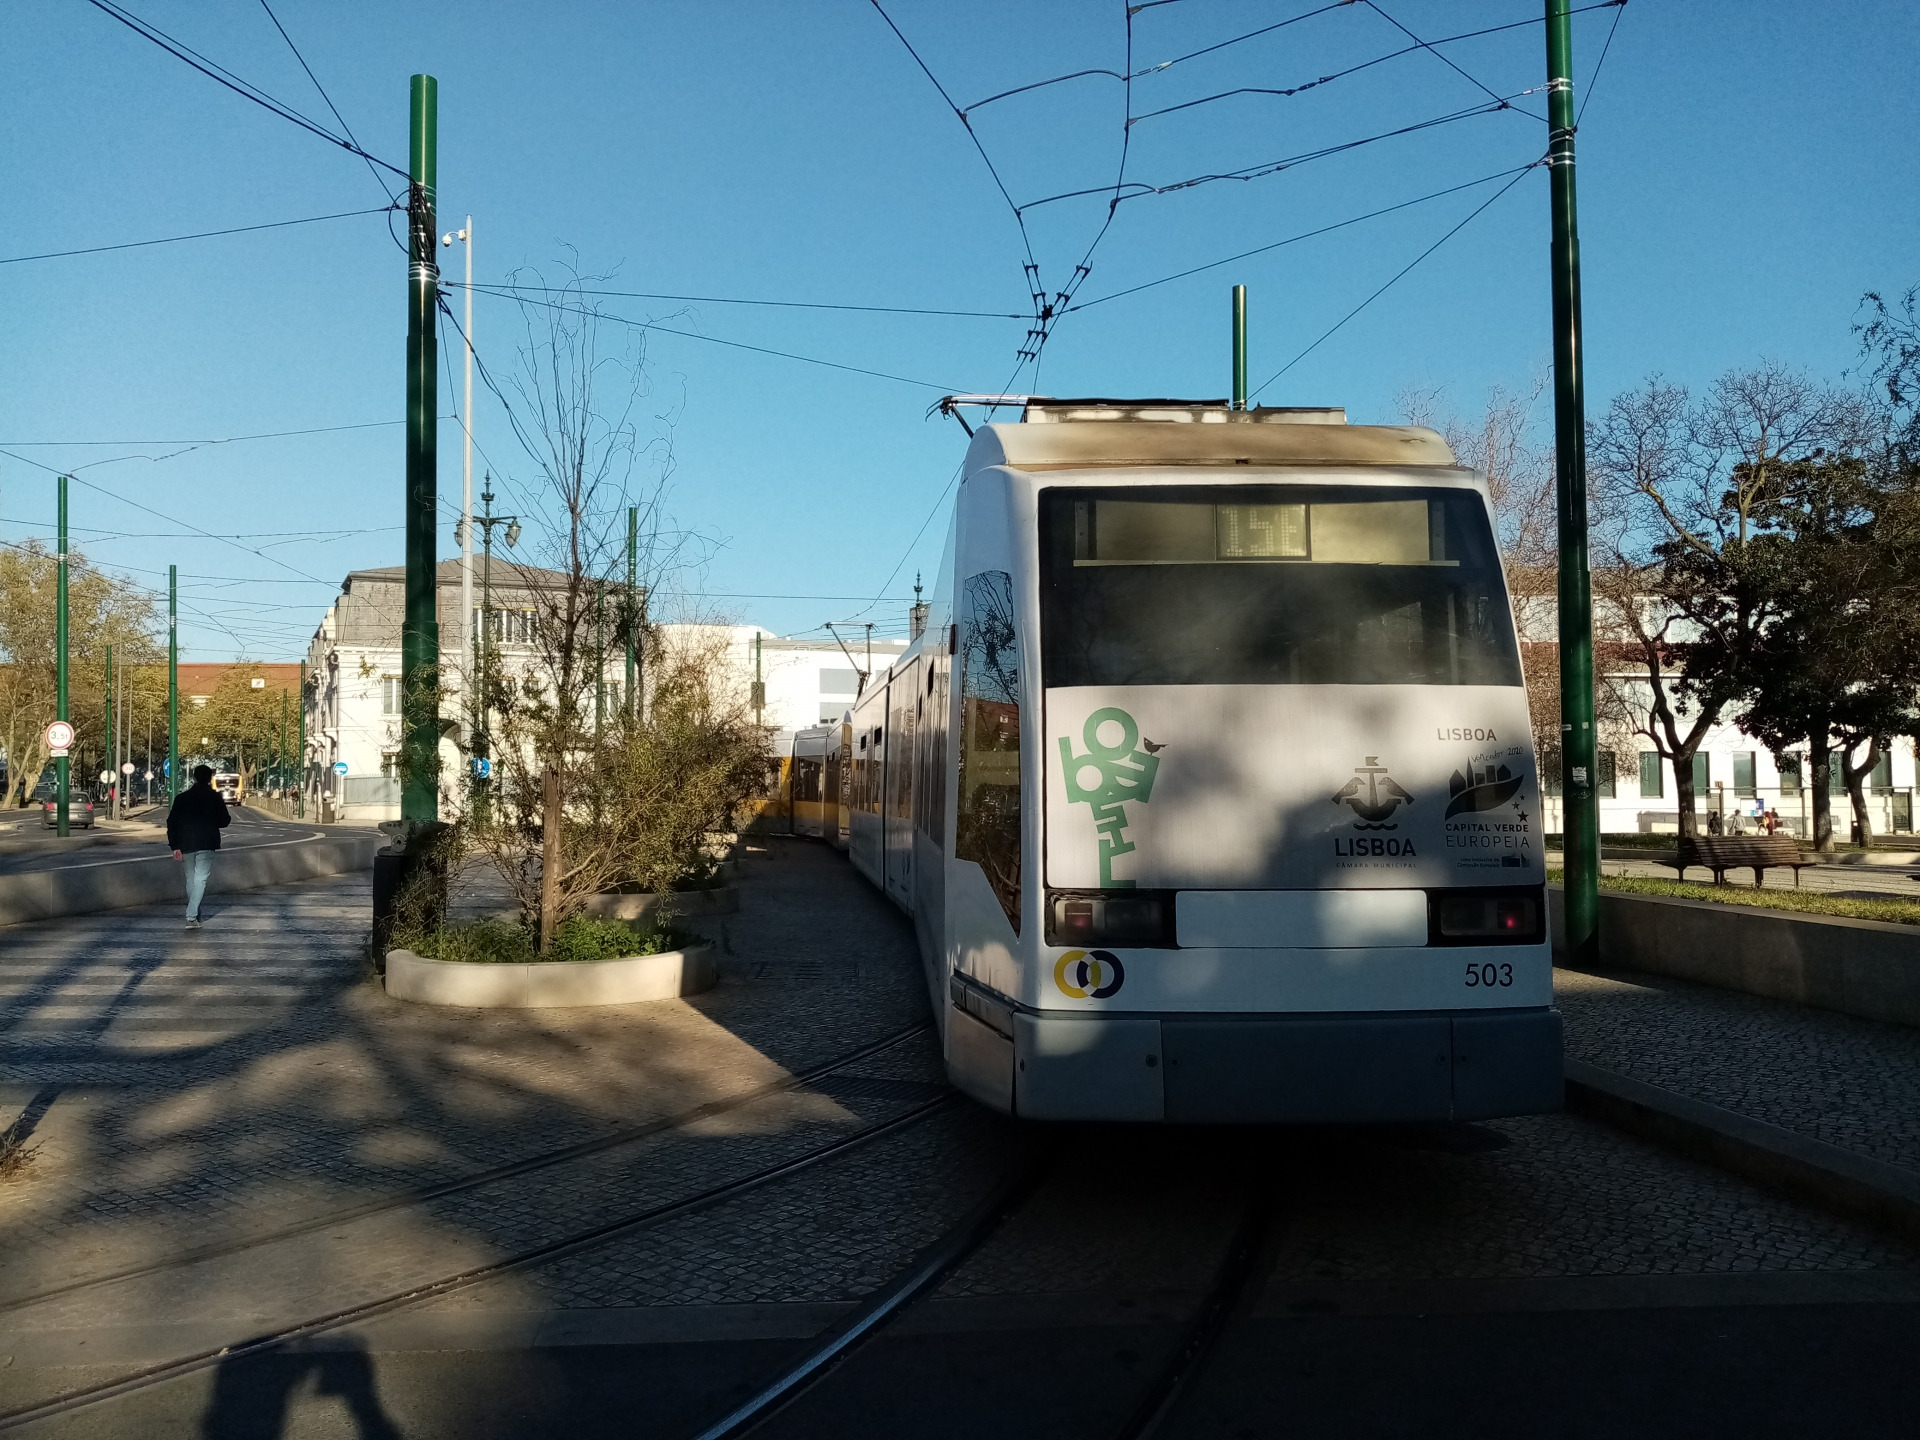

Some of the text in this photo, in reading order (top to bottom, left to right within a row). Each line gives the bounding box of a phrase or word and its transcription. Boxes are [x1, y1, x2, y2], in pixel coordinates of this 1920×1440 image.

[1437, 728, 1497, 741] LISBOA
[1445, 823, 1529, 833] CAPITAL VERDE
[1335, 837, 1417, 857] LISBOA
[1446, 835, 1530, 848] EUROPEIA
[1464, 963, 1514, 988] 503
